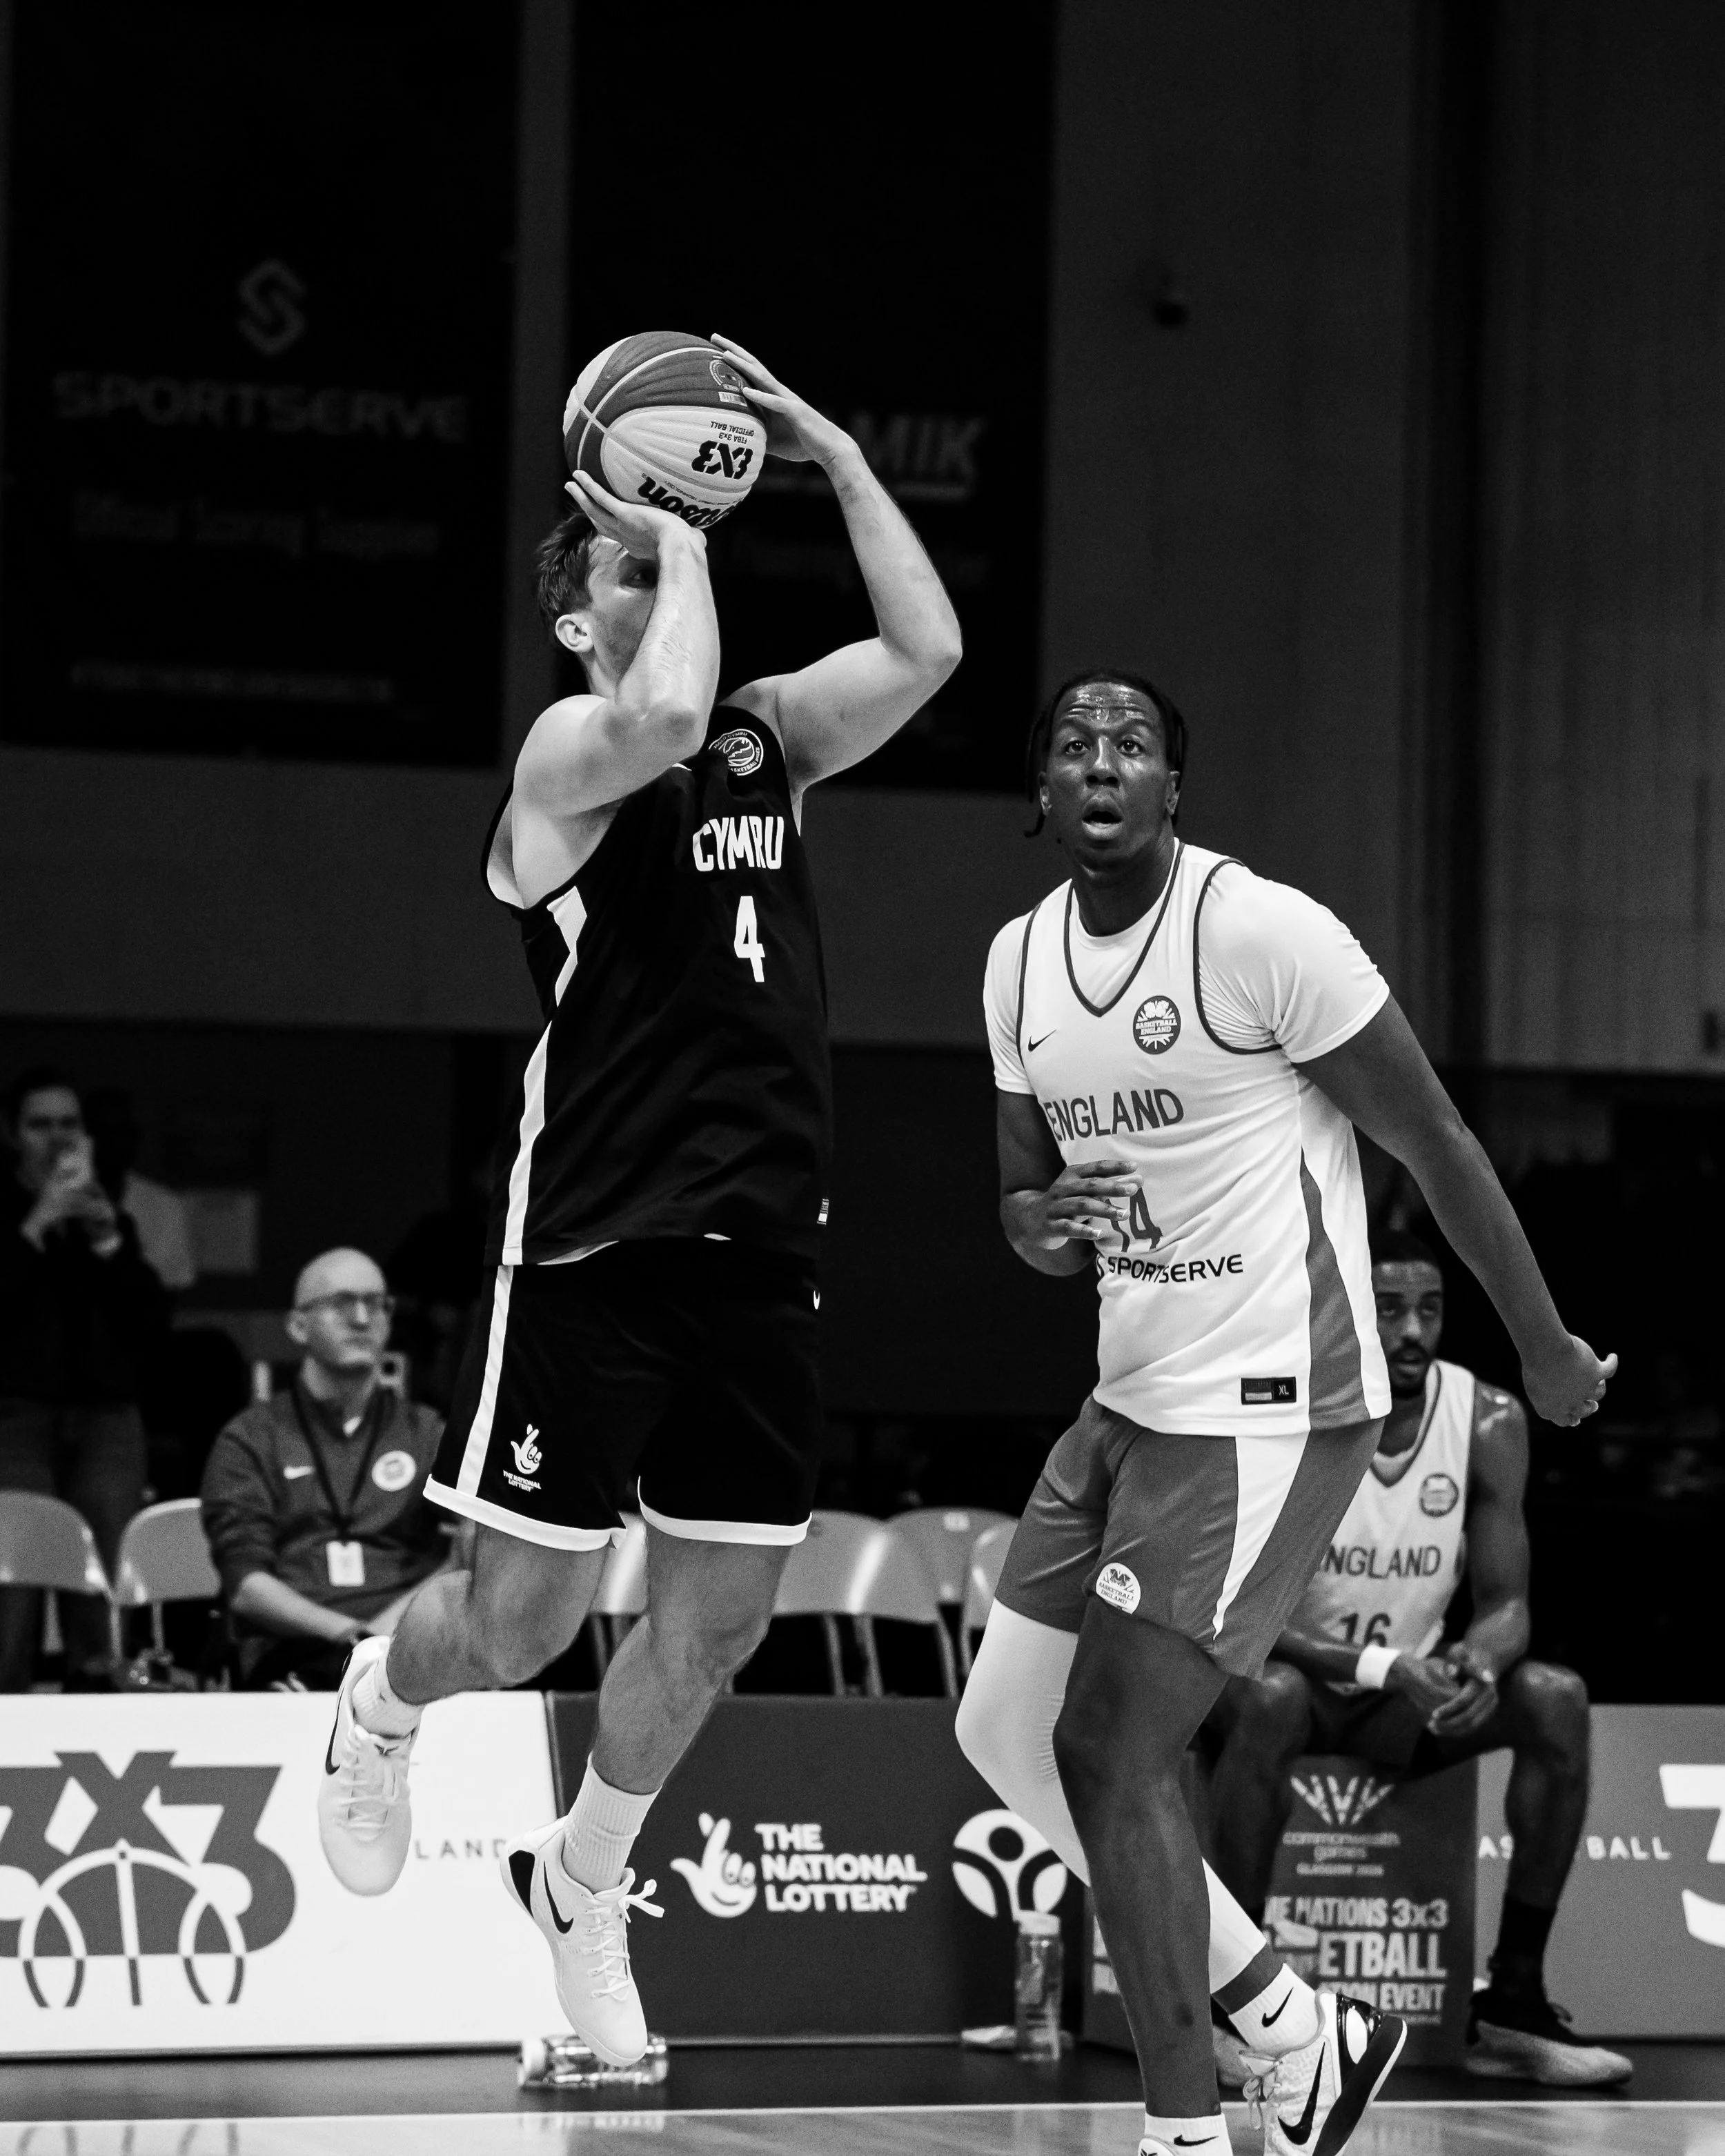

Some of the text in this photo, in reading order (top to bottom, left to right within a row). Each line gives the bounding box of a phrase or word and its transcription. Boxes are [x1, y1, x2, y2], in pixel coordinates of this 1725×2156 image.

[50, 370, 473, 445] SPORTSERVE
[710, 421, 754, 437] OFFICIAL BALL
[733, 435, 748, 444] FIBA
[693, 815, 784, 871] CYMRU
[734, 896, 765, 982] 4
[1141, 1026, 1172, 1035] ENGLAND
[1043, 1089, 1184, 1141] ENGLAND
[1107, 1254, 1243, 1283] SPORTSERVE
[1279, 1384, 1289, 1395] XL
[503, 1470, 513, 1480] THE
[509, 1478, 533, 1492] LOTTERY
[513, 1474, 542, 1490] NATIONAL
[1324, 1545, 1441, 1579] NGLAND
[1340, 1612, 1391, 1648] 16
[754, 1823, 825, 1852] THE
[760, 1852, 928, 1882] NATIONAL
[765, 1883, 912, 1912] LOTTERY
[1294, 1896, 1389, 1927] NATIONS
[1319, 1932, 1447, 1978] ETBALL
[1381, 1982, 1446, 2010] EVENT
